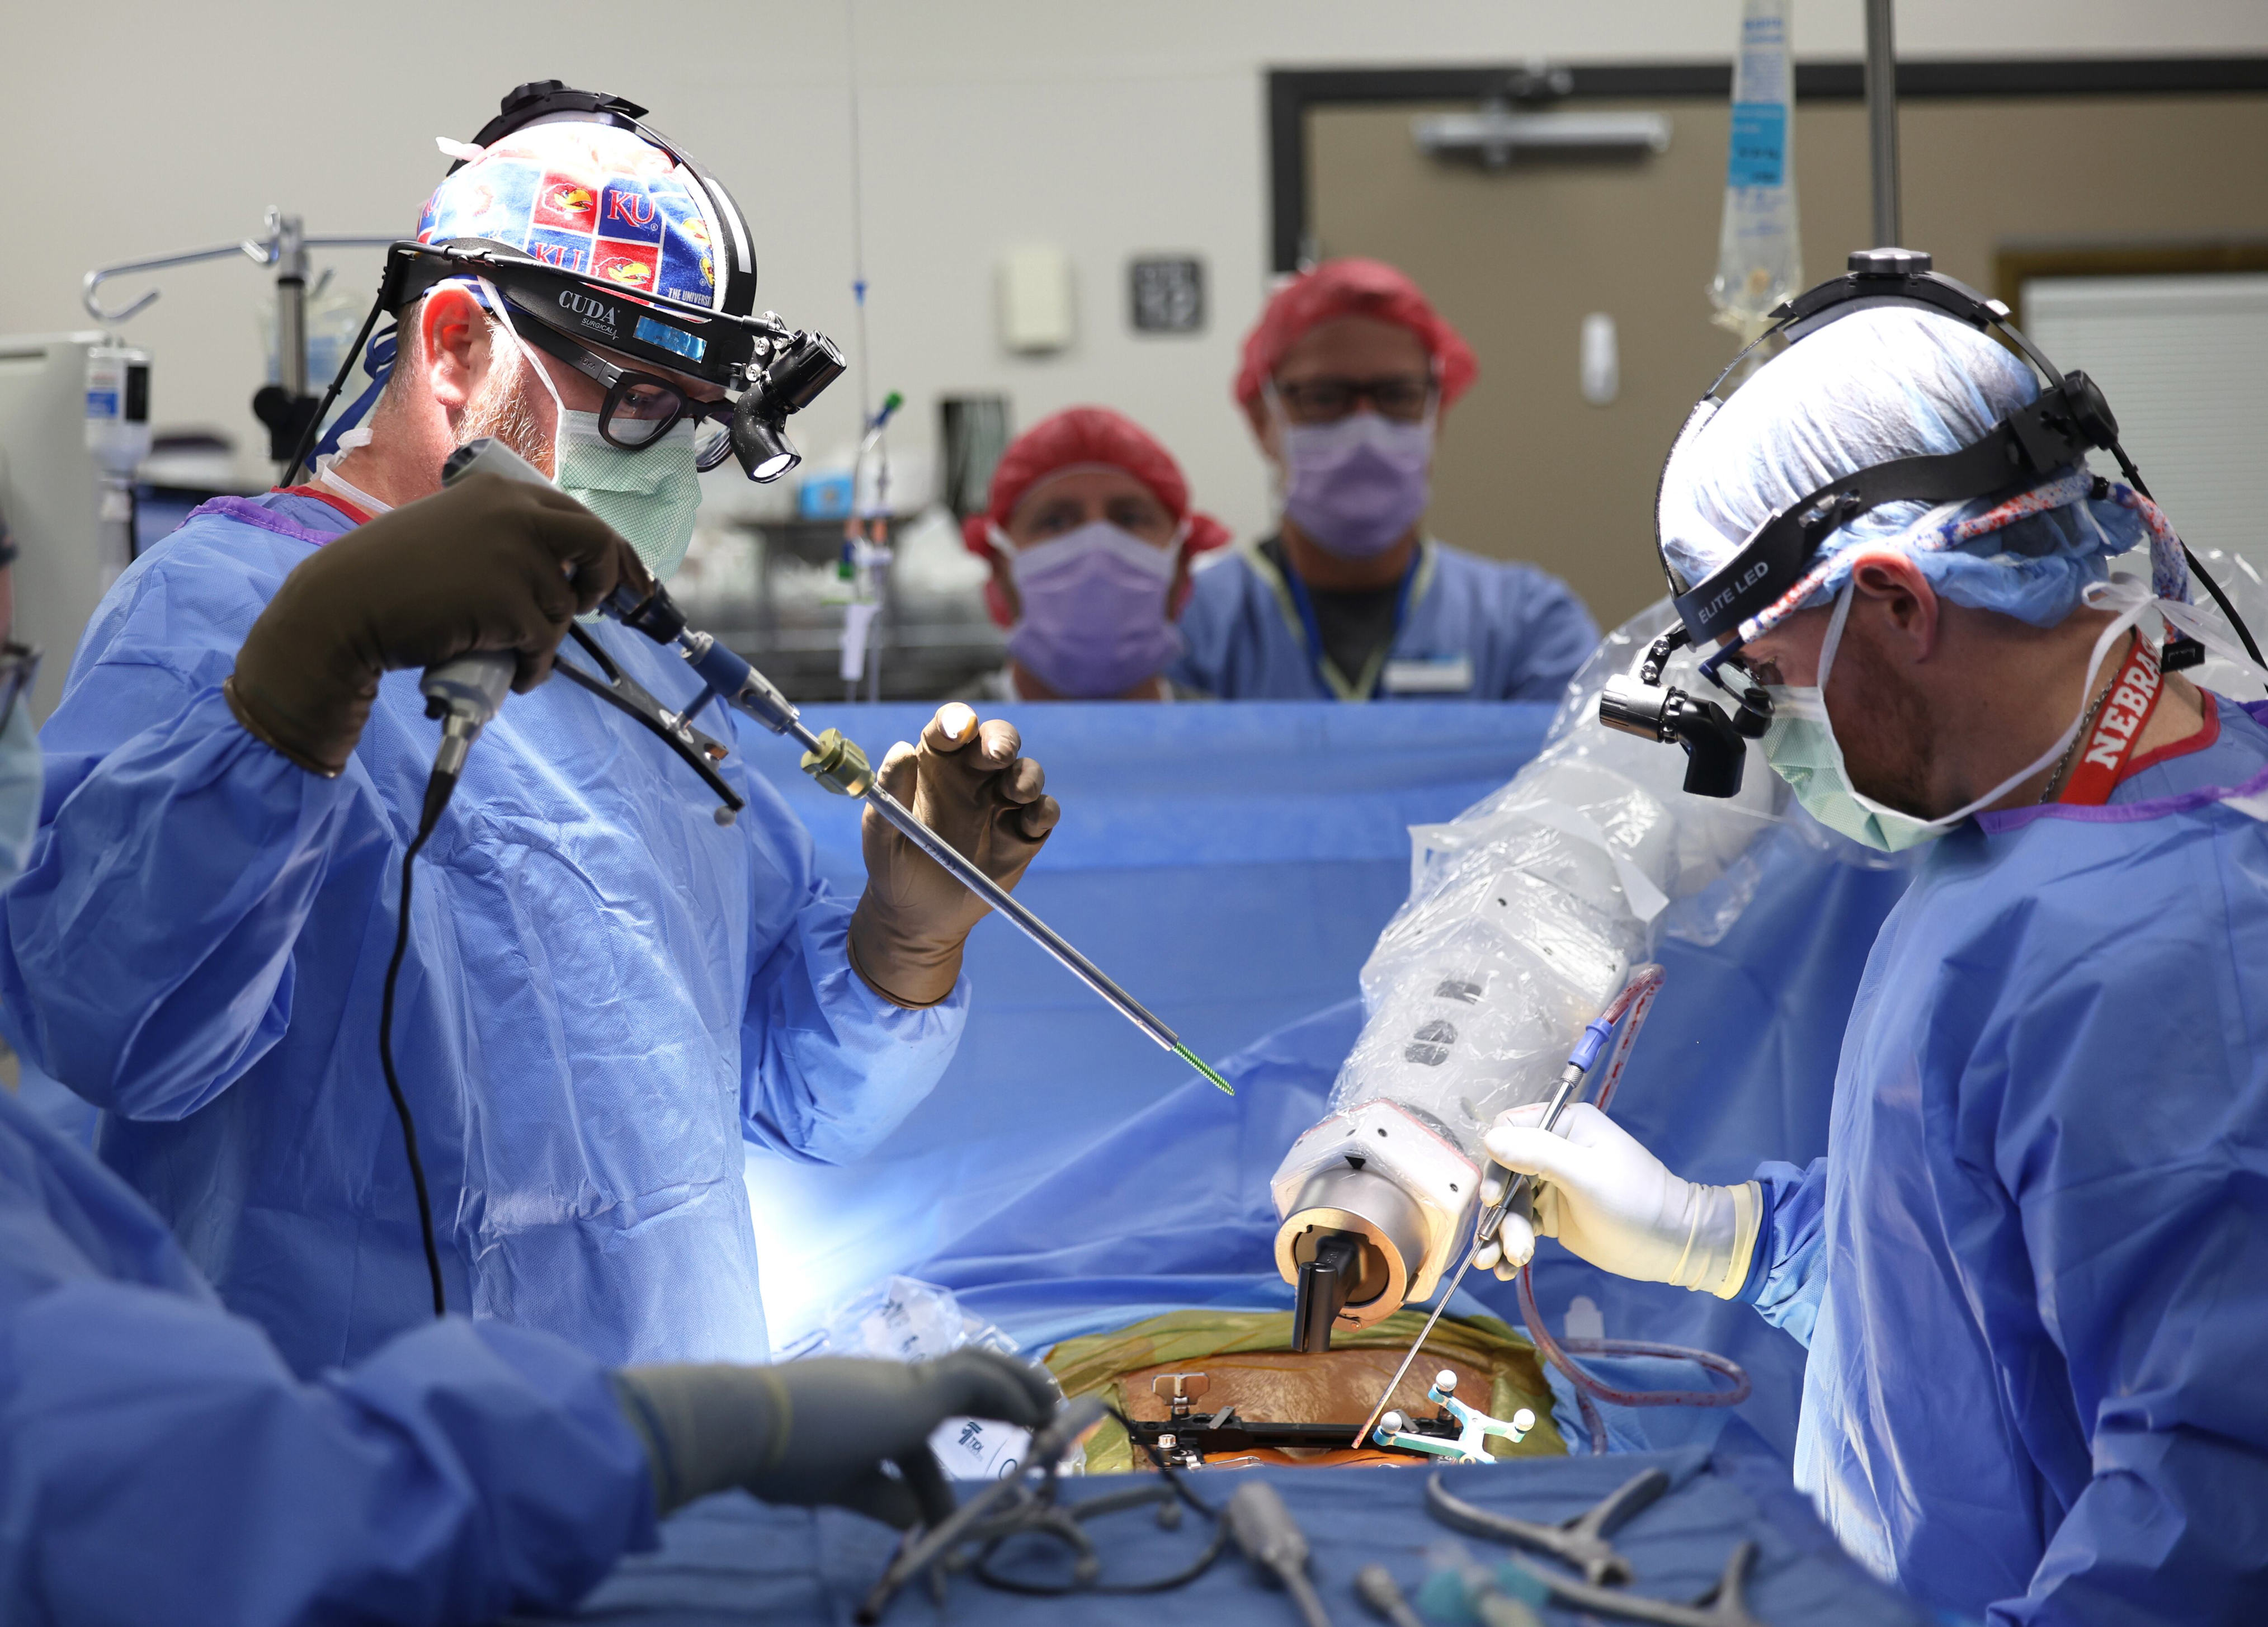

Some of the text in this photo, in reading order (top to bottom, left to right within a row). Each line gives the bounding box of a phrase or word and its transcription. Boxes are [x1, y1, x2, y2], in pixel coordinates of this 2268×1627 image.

[607, 190, 656, 228] KU
[559, 290, 616, 326] CUDA
[668, 287, 682, 300] THE
[582, 318, 614, 334] SURGICAL
[1698, 562, 1769, 624] ELITE LED
